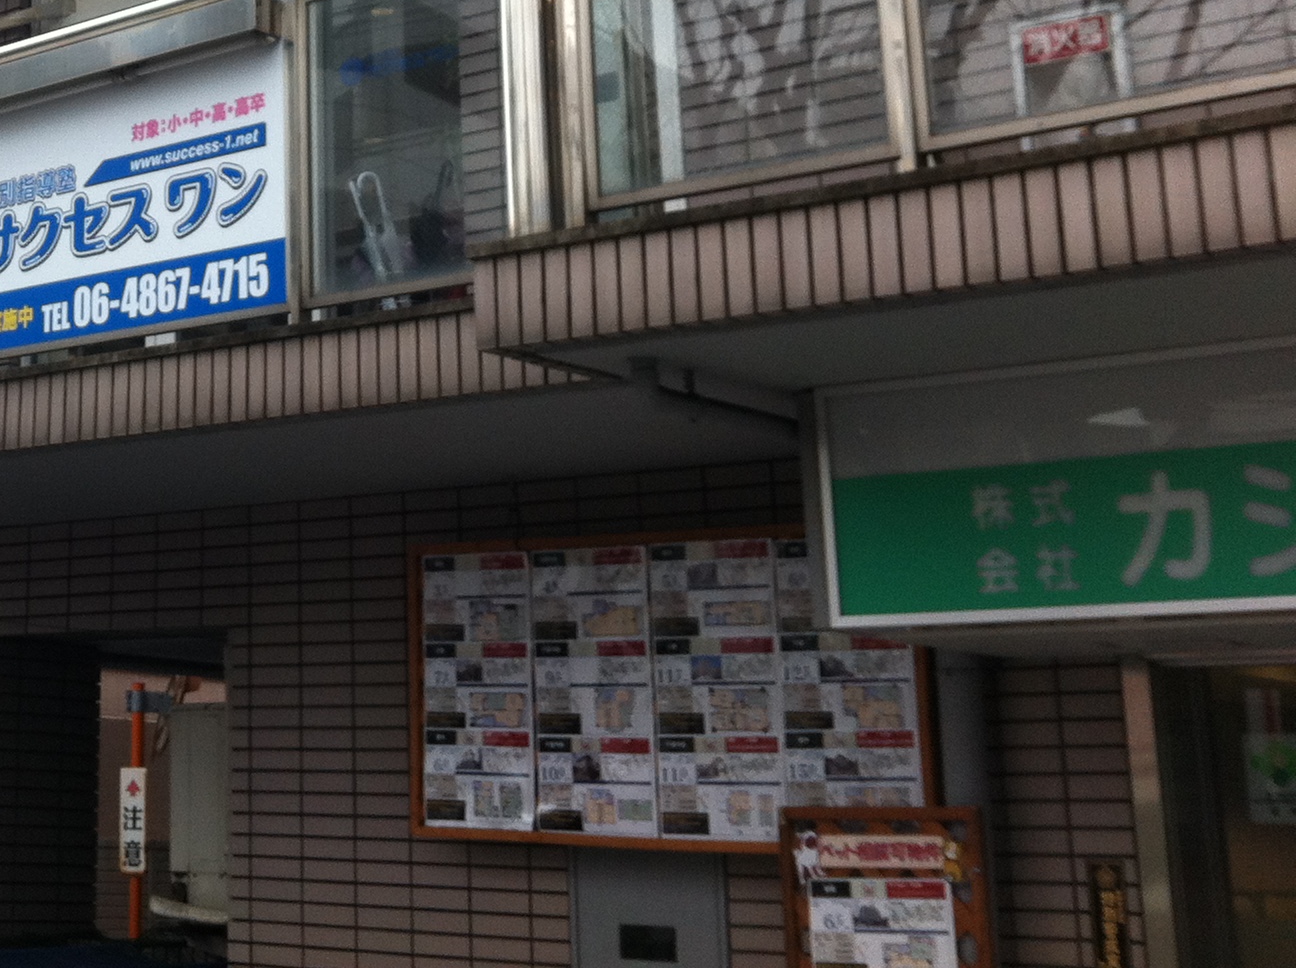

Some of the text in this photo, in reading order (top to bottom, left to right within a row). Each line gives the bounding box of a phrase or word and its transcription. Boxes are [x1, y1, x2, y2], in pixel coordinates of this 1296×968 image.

[130, 129, 259, 172] www.success-1.net
[41, 252, 269, 333] TEL 06-4867-4715
[122, 805, 143, 868] 注意
